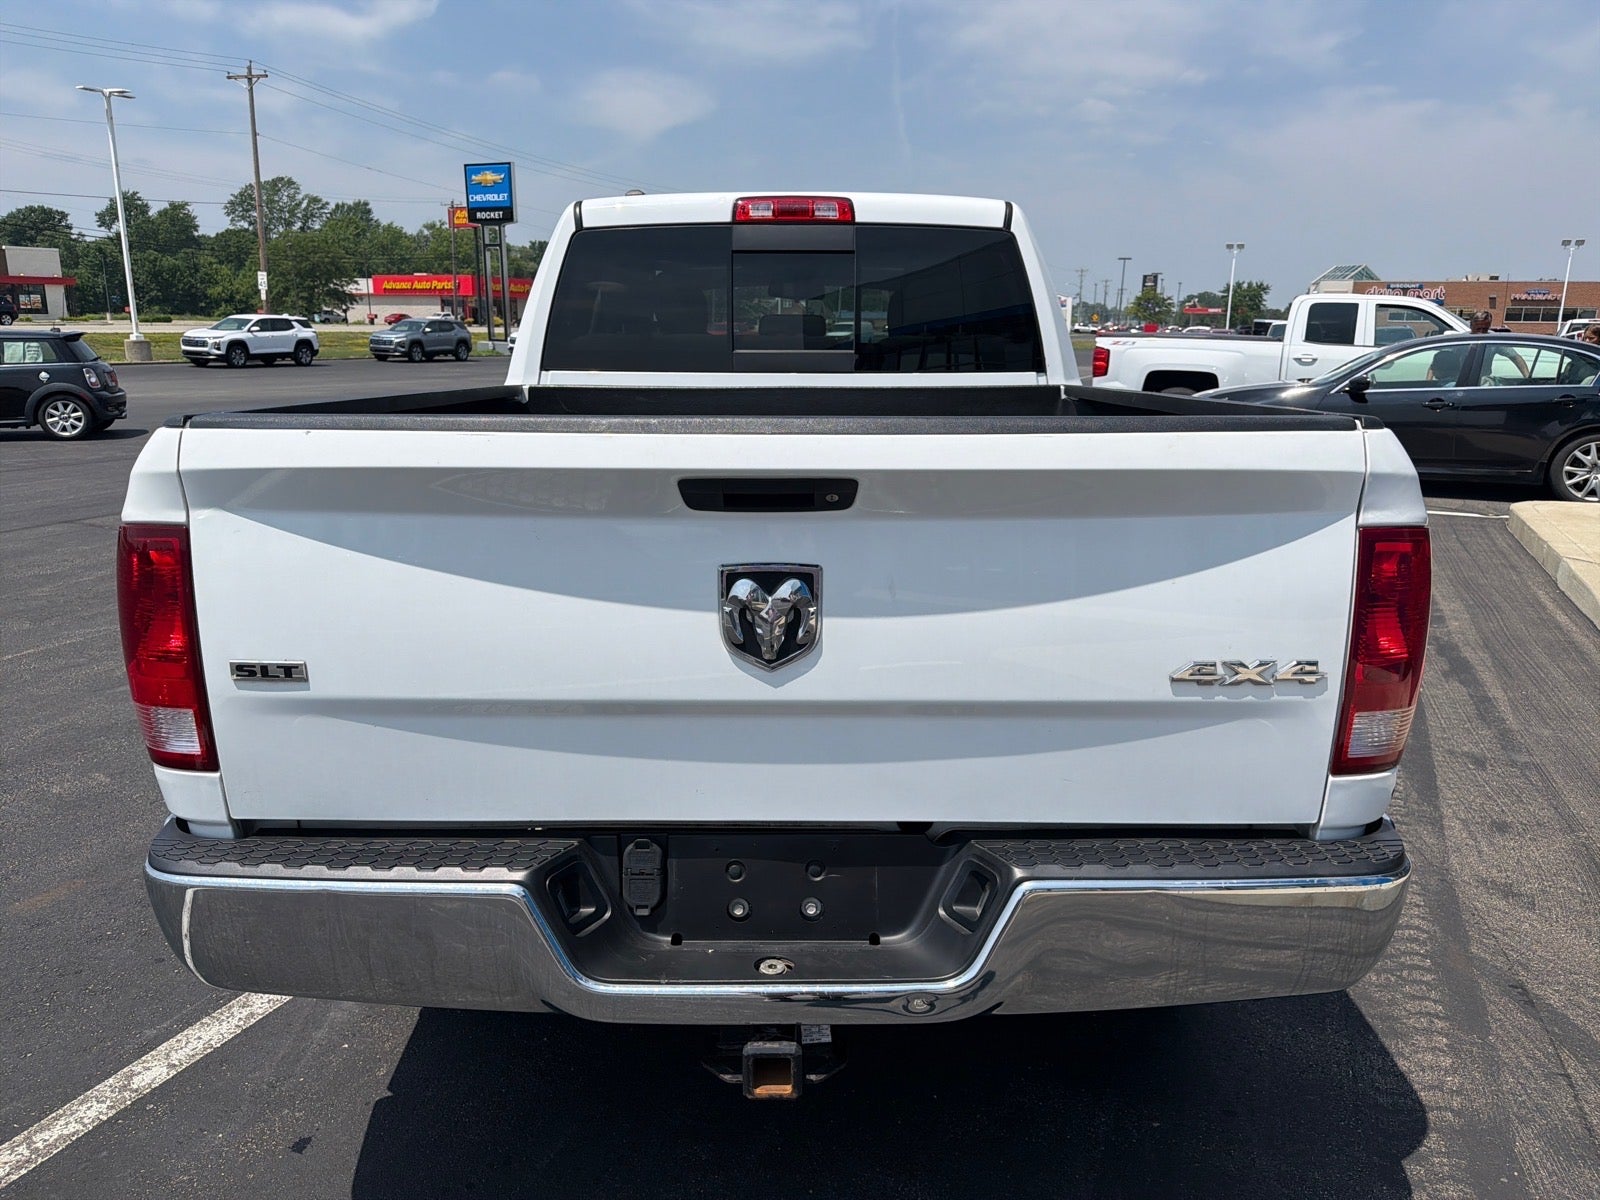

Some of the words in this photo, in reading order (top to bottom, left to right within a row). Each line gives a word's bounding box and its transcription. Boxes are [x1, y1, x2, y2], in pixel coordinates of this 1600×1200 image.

[469, 193, 508, 202] CHEVROLET
[476, 211, 503, 219] ROCKET
[383, 280, 412, 290] Advance
[412, 280, 431, 290] Auto
[1407, 286, 1446, 299] mart
[235, 664, 299, 679] SLT
